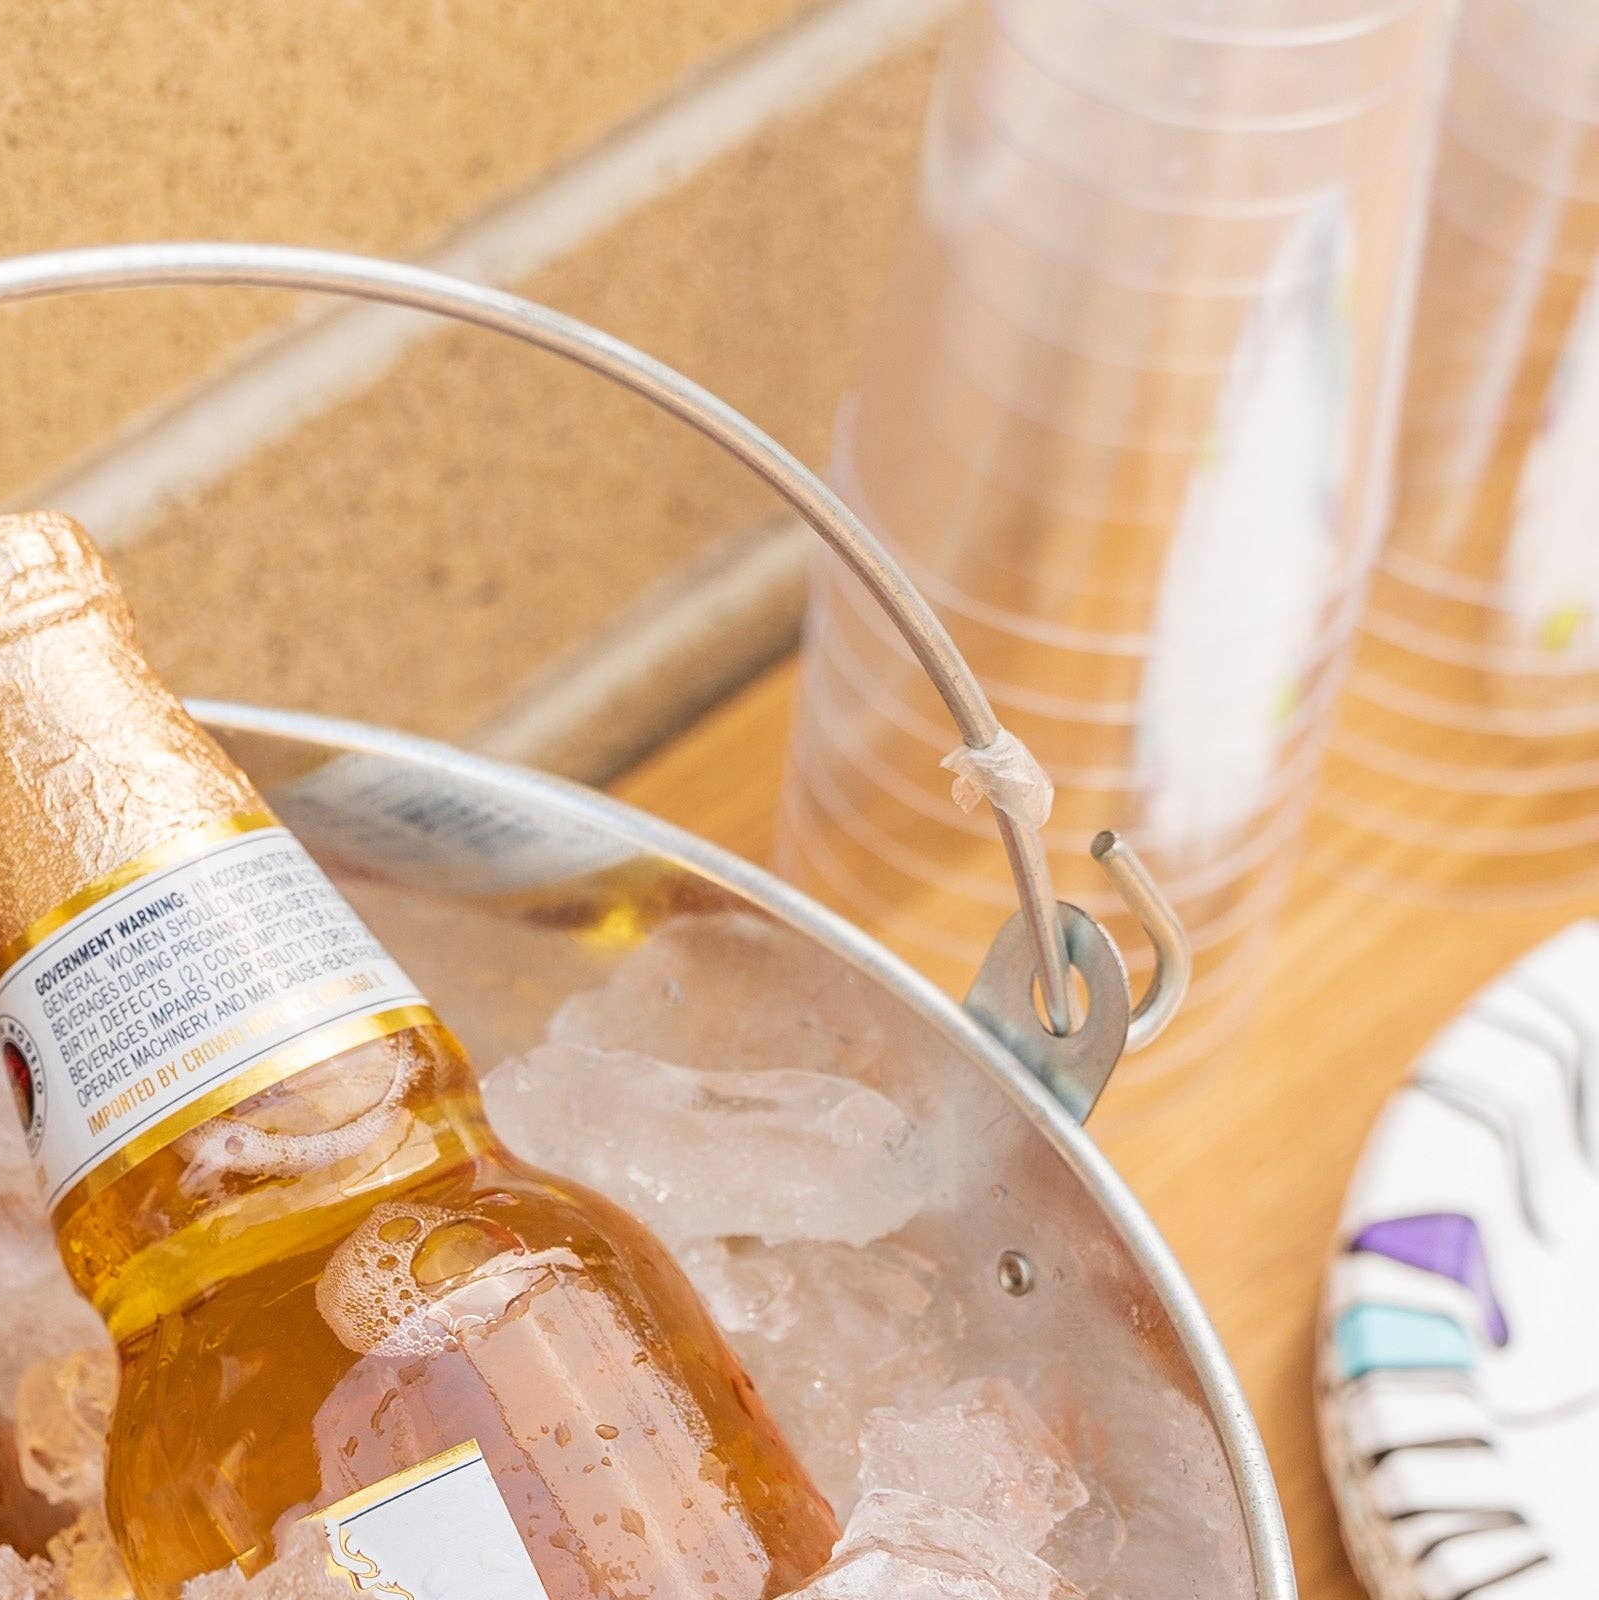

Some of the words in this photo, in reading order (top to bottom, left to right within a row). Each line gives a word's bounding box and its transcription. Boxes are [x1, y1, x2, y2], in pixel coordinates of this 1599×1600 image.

[34, 928, 117, 997] GOVERNMENT
[114, 892, 190, 939] WARNING:
[51, 981, 121, 1042] BEVERAGES
[118, 950, 174, 993] DURING
[170, 911, 254, 963] PREGNANCY
[60, 1022, 100, 1065] BIRTH
[177, 961, 205, 992] (2)
[203, 917, 311, 972] CONSUMPTION
[105, 927, 167, 972] WOMEN
[165, 896, 230, 937] SHOULD
[228, 882, 261, 905] NOT
[68, 1019, 149, 1087] BEVERAGES
[147, 984, 212, 1030] IMPAIRS
[208, 960, 258, 995] YOUR
[256, 941, 305, 972] ABILITY
[76, 1057, 133, 1109] OPERATE
[130, 1008, 218, 1070] MACHINERY,
[214, 992, 247, 1022] AND
[244, 977, 279, 1009] MAY
[276, 960, 324, 990] CAUSE
[86, 1076, 157, 1138] IMPORTED
[155, 1060, 180, 1089] BY
[181, 1026, 246, 1074] CROWN
